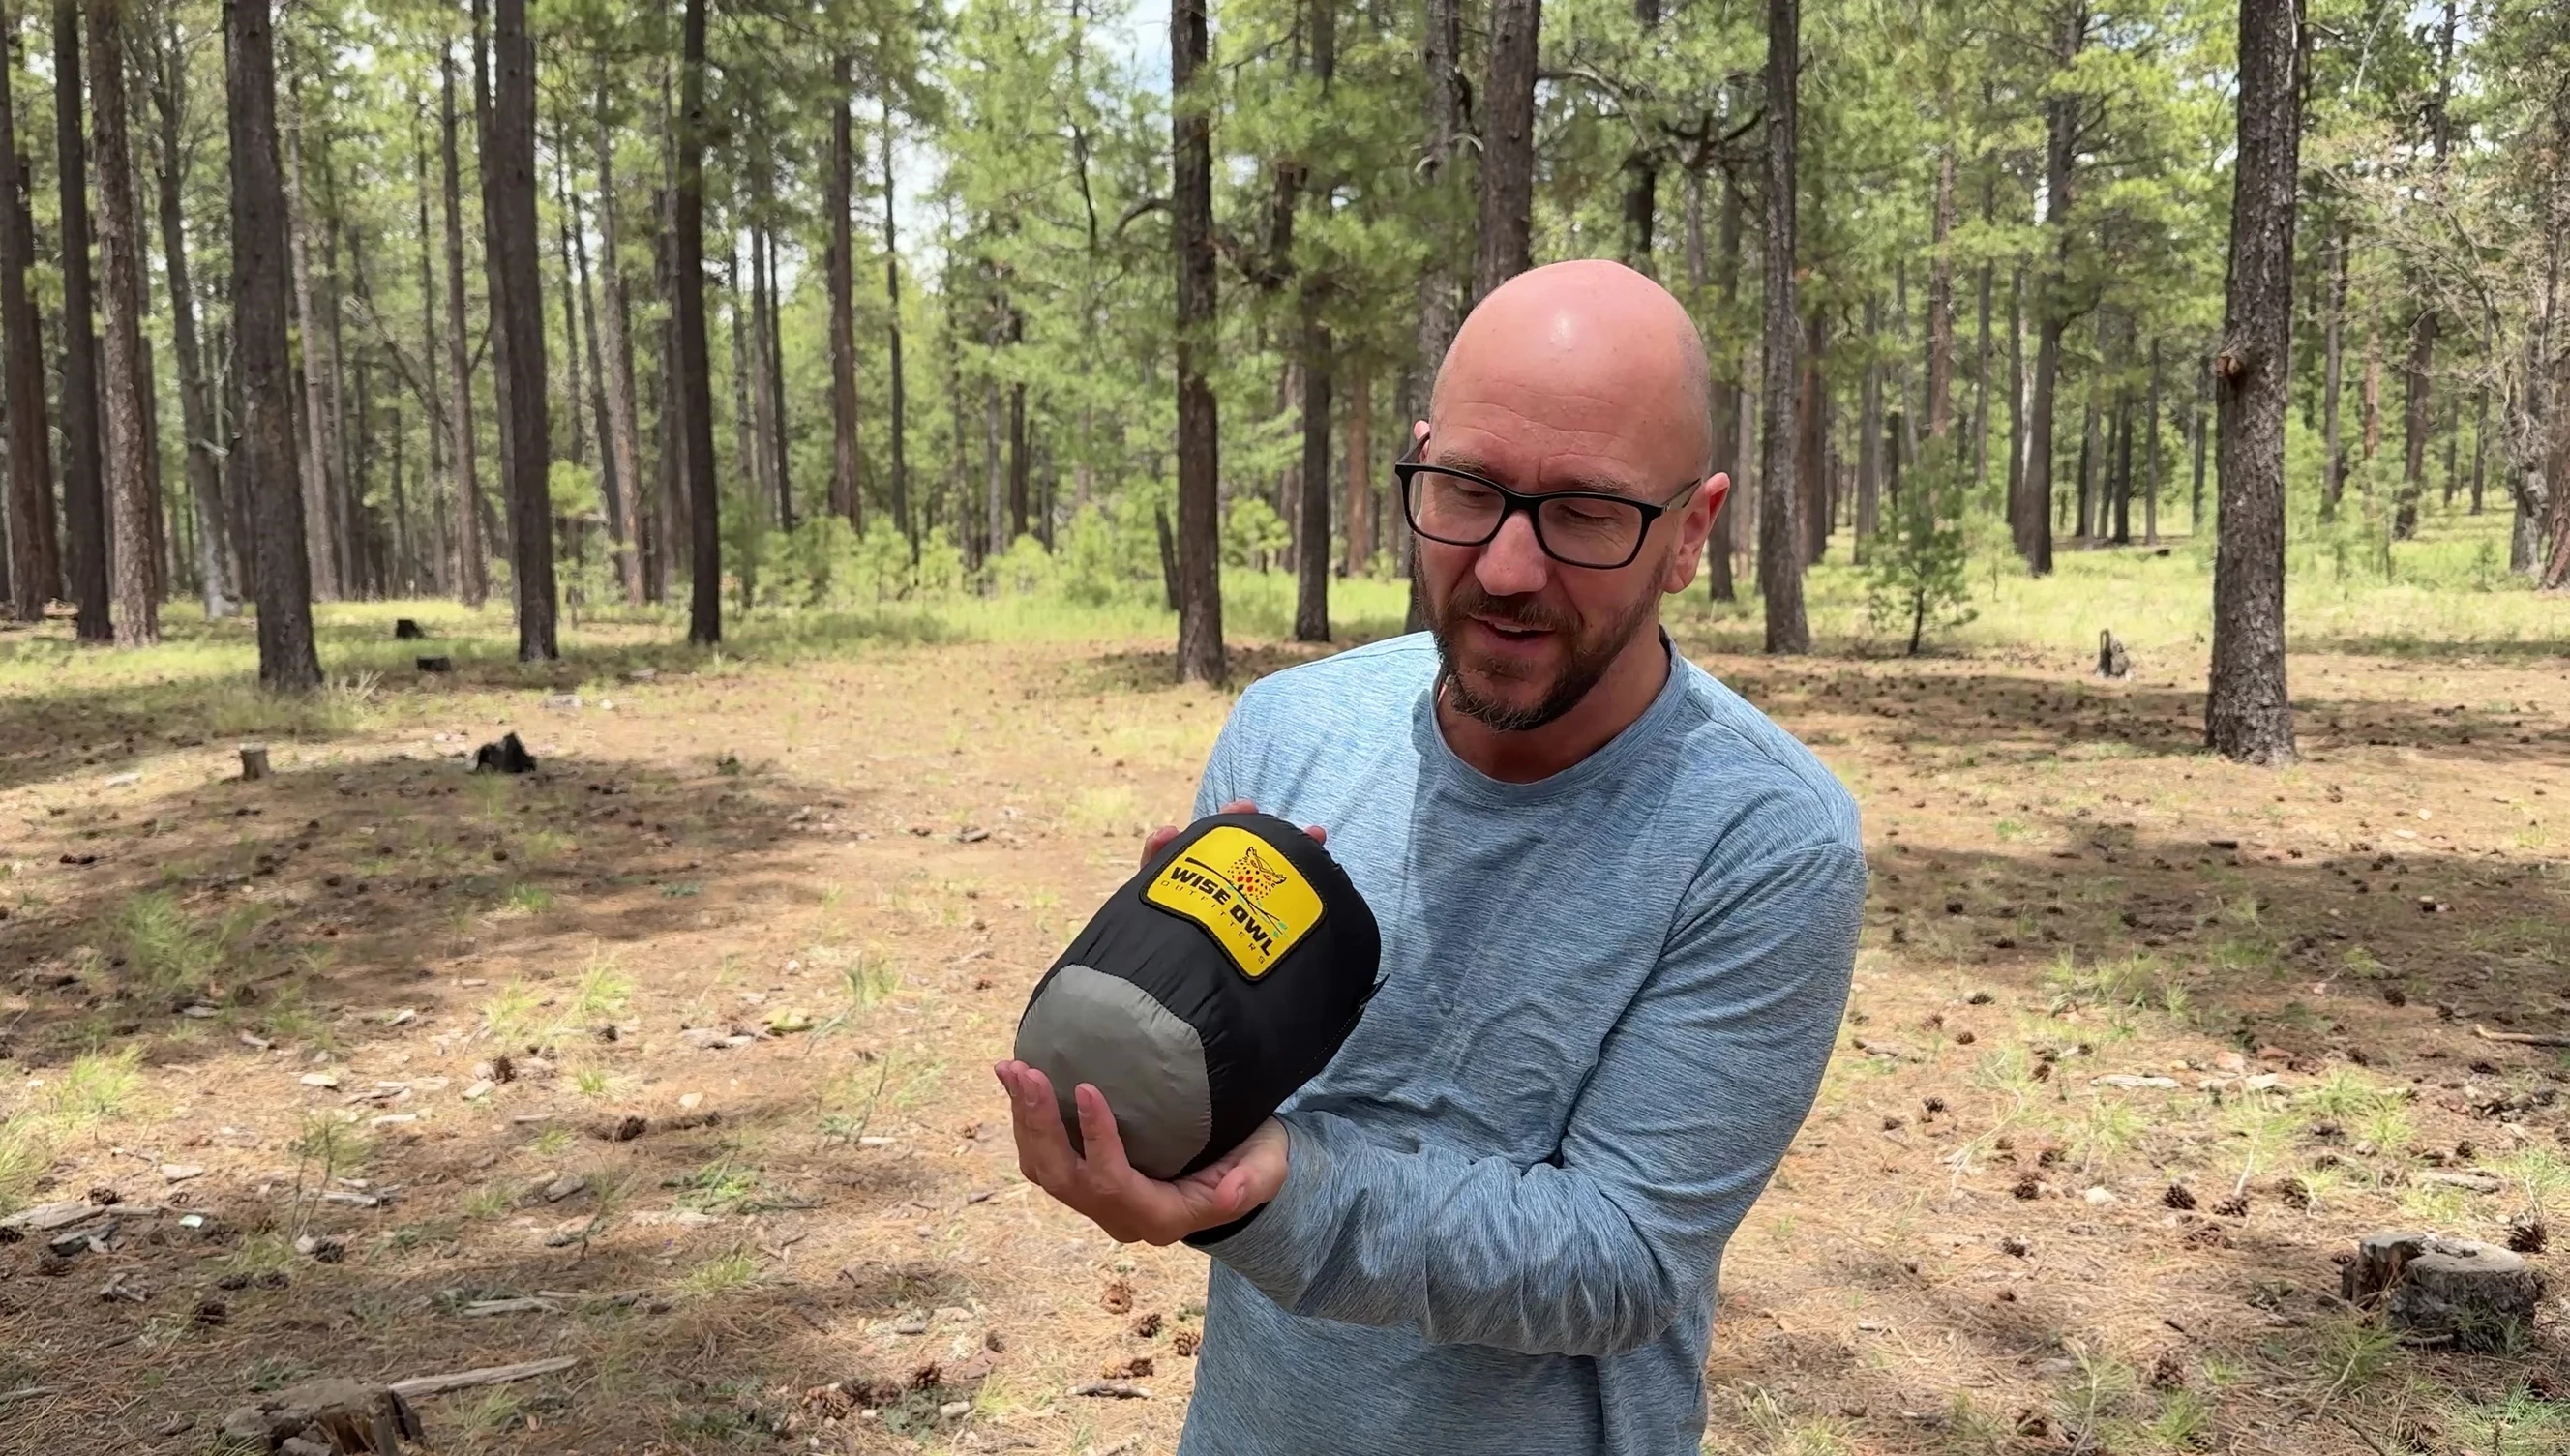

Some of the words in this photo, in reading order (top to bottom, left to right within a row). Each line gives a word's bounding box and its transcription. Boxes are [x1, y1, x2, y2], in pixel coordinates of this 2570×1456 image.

[1160, 880, 1266, 964] OUTFITTERS
[1170, 866, 1231, 906] WISE
[1230, 904, 1273, 956] OWL
